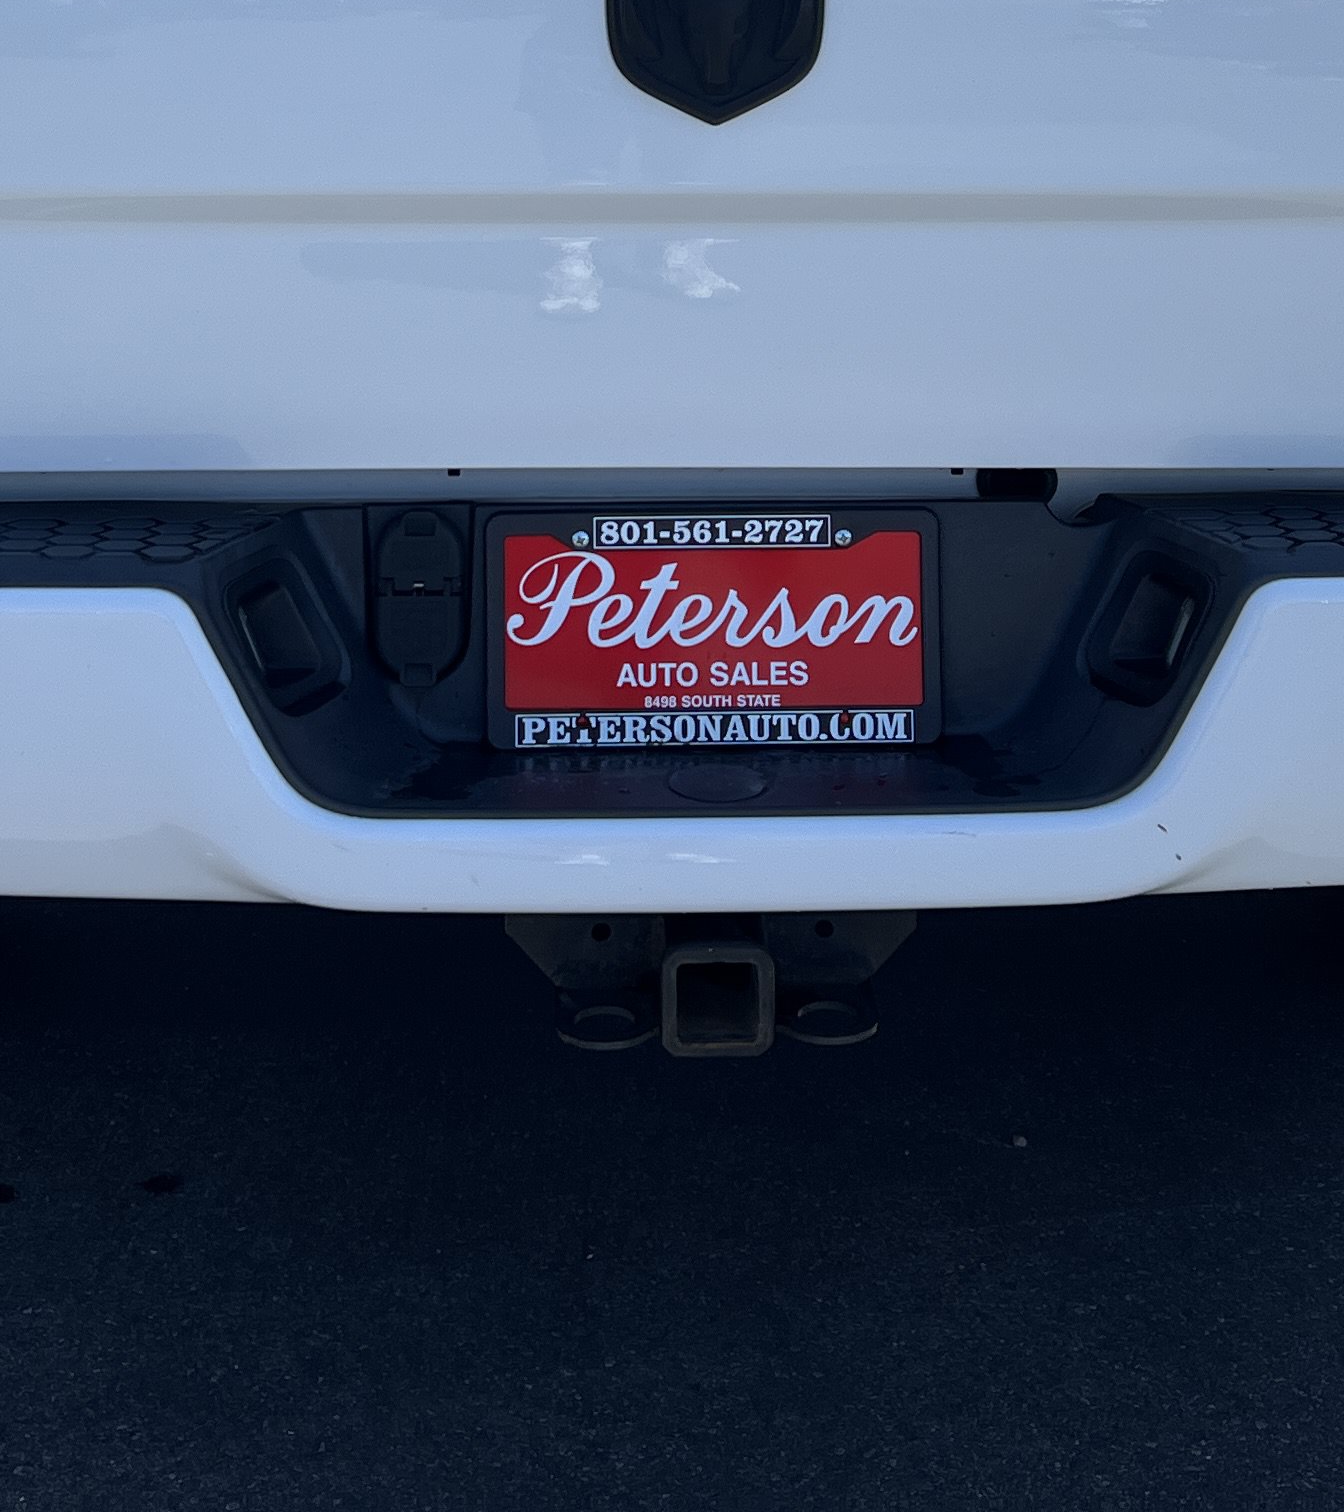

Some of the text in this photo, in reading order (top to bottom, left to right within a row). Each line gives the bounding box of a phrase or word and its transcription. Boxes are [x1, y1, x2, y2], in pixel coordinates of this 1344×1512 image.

[599, 519, 825, 546] 801-561-2727
[506, 550, 919, 649] Peterson
[616, 660, 809, 688] AUTO SALES
[644, 693, 781, 709] 8498 SOUTH STATE
[521, 712, 908, 745] PETERSONAUTO.COM
